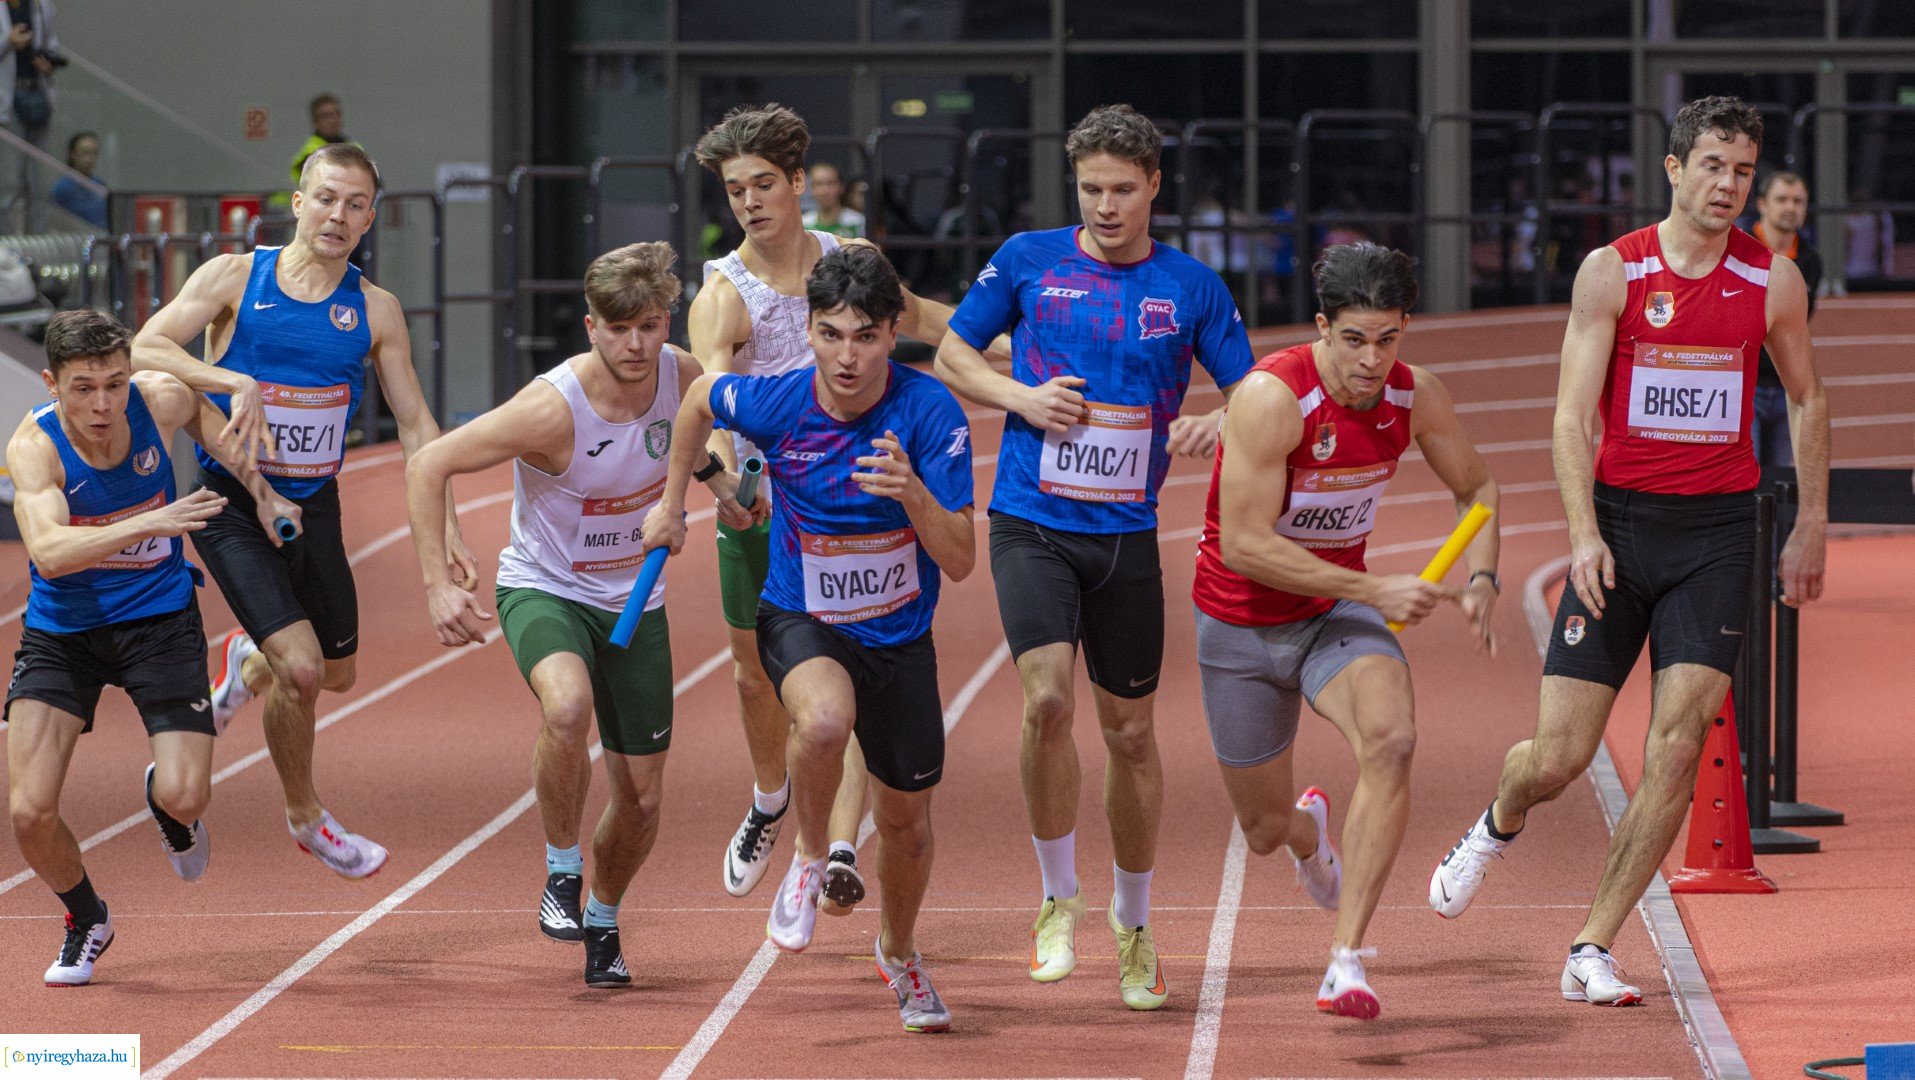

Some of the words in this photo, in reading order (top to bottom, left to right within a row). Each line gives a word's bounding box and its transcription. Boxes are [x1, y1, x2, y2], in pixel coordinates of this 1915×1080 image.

[1146, 303, 1170, 313] GYAC
[1676, 351, 1734, 361] FEDETTPÁLYÁS
[279, 390, 291, 398] 49.
[293, 389, 344, 399] FEDETTPÁLYÁS
[1644, 385, 1728, 419] BHSE/1
[1091, 408, 1147, 420] FEDETTPÁLYÁS
[1640, 429, 1706, 442] NYÍREGYHÁZA
[1708, 434, 1728, 442] 2023
[1056, 440, 1138, 477] GYAC/1
[1051, 485, 1115, 501] NYÍREGYHÁZA
[1117, 492, 1136, 500] 2023
[1290, 497, 1373, 530] BHSE/2
[584, 531, 621, 548] MATE
[819, 562, 907, 600] GYAC/2
[820, 605, 889, 622] NYÍREGYHÁZA
